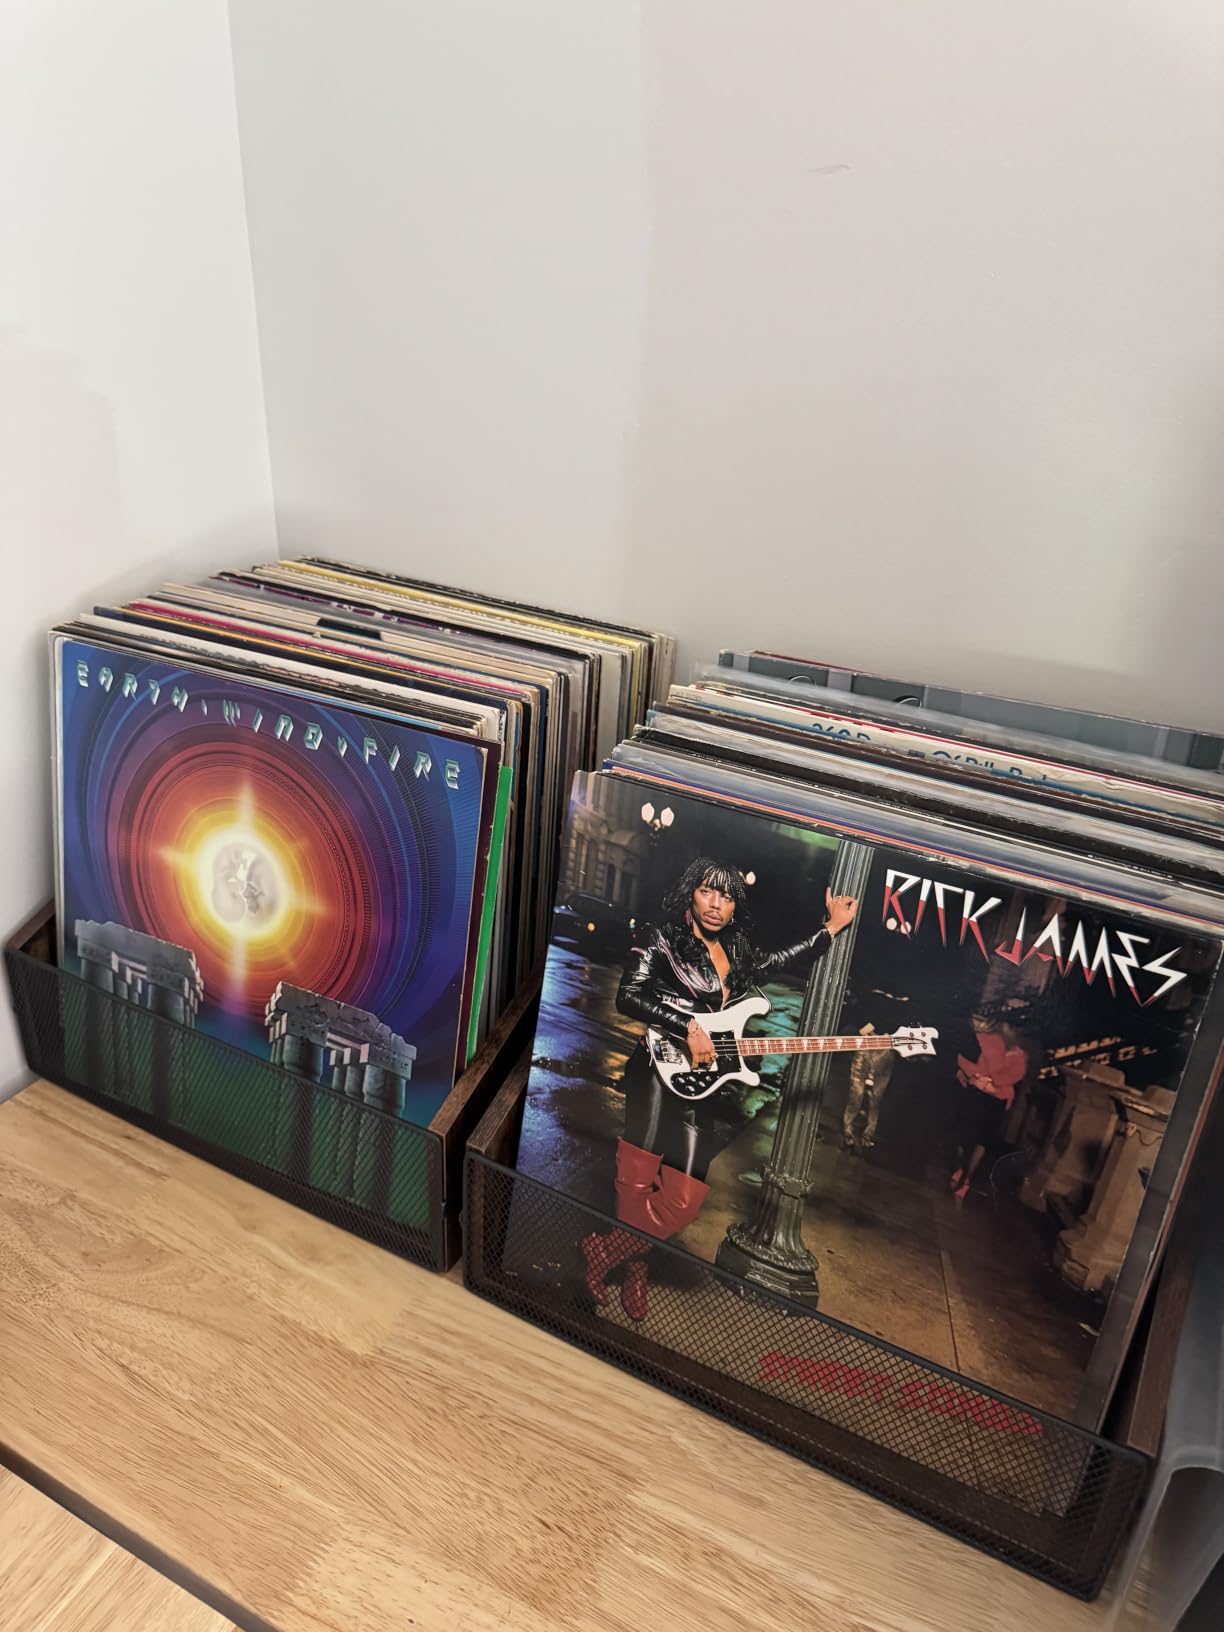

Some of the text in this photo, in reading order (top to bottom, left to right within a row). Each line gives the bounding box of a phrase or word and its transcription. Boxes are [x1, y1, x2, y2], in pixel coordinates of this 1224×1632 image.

[363, 736, 461, 790] FIRE
[882, 868, 1188, 1008] RICK JAMES
